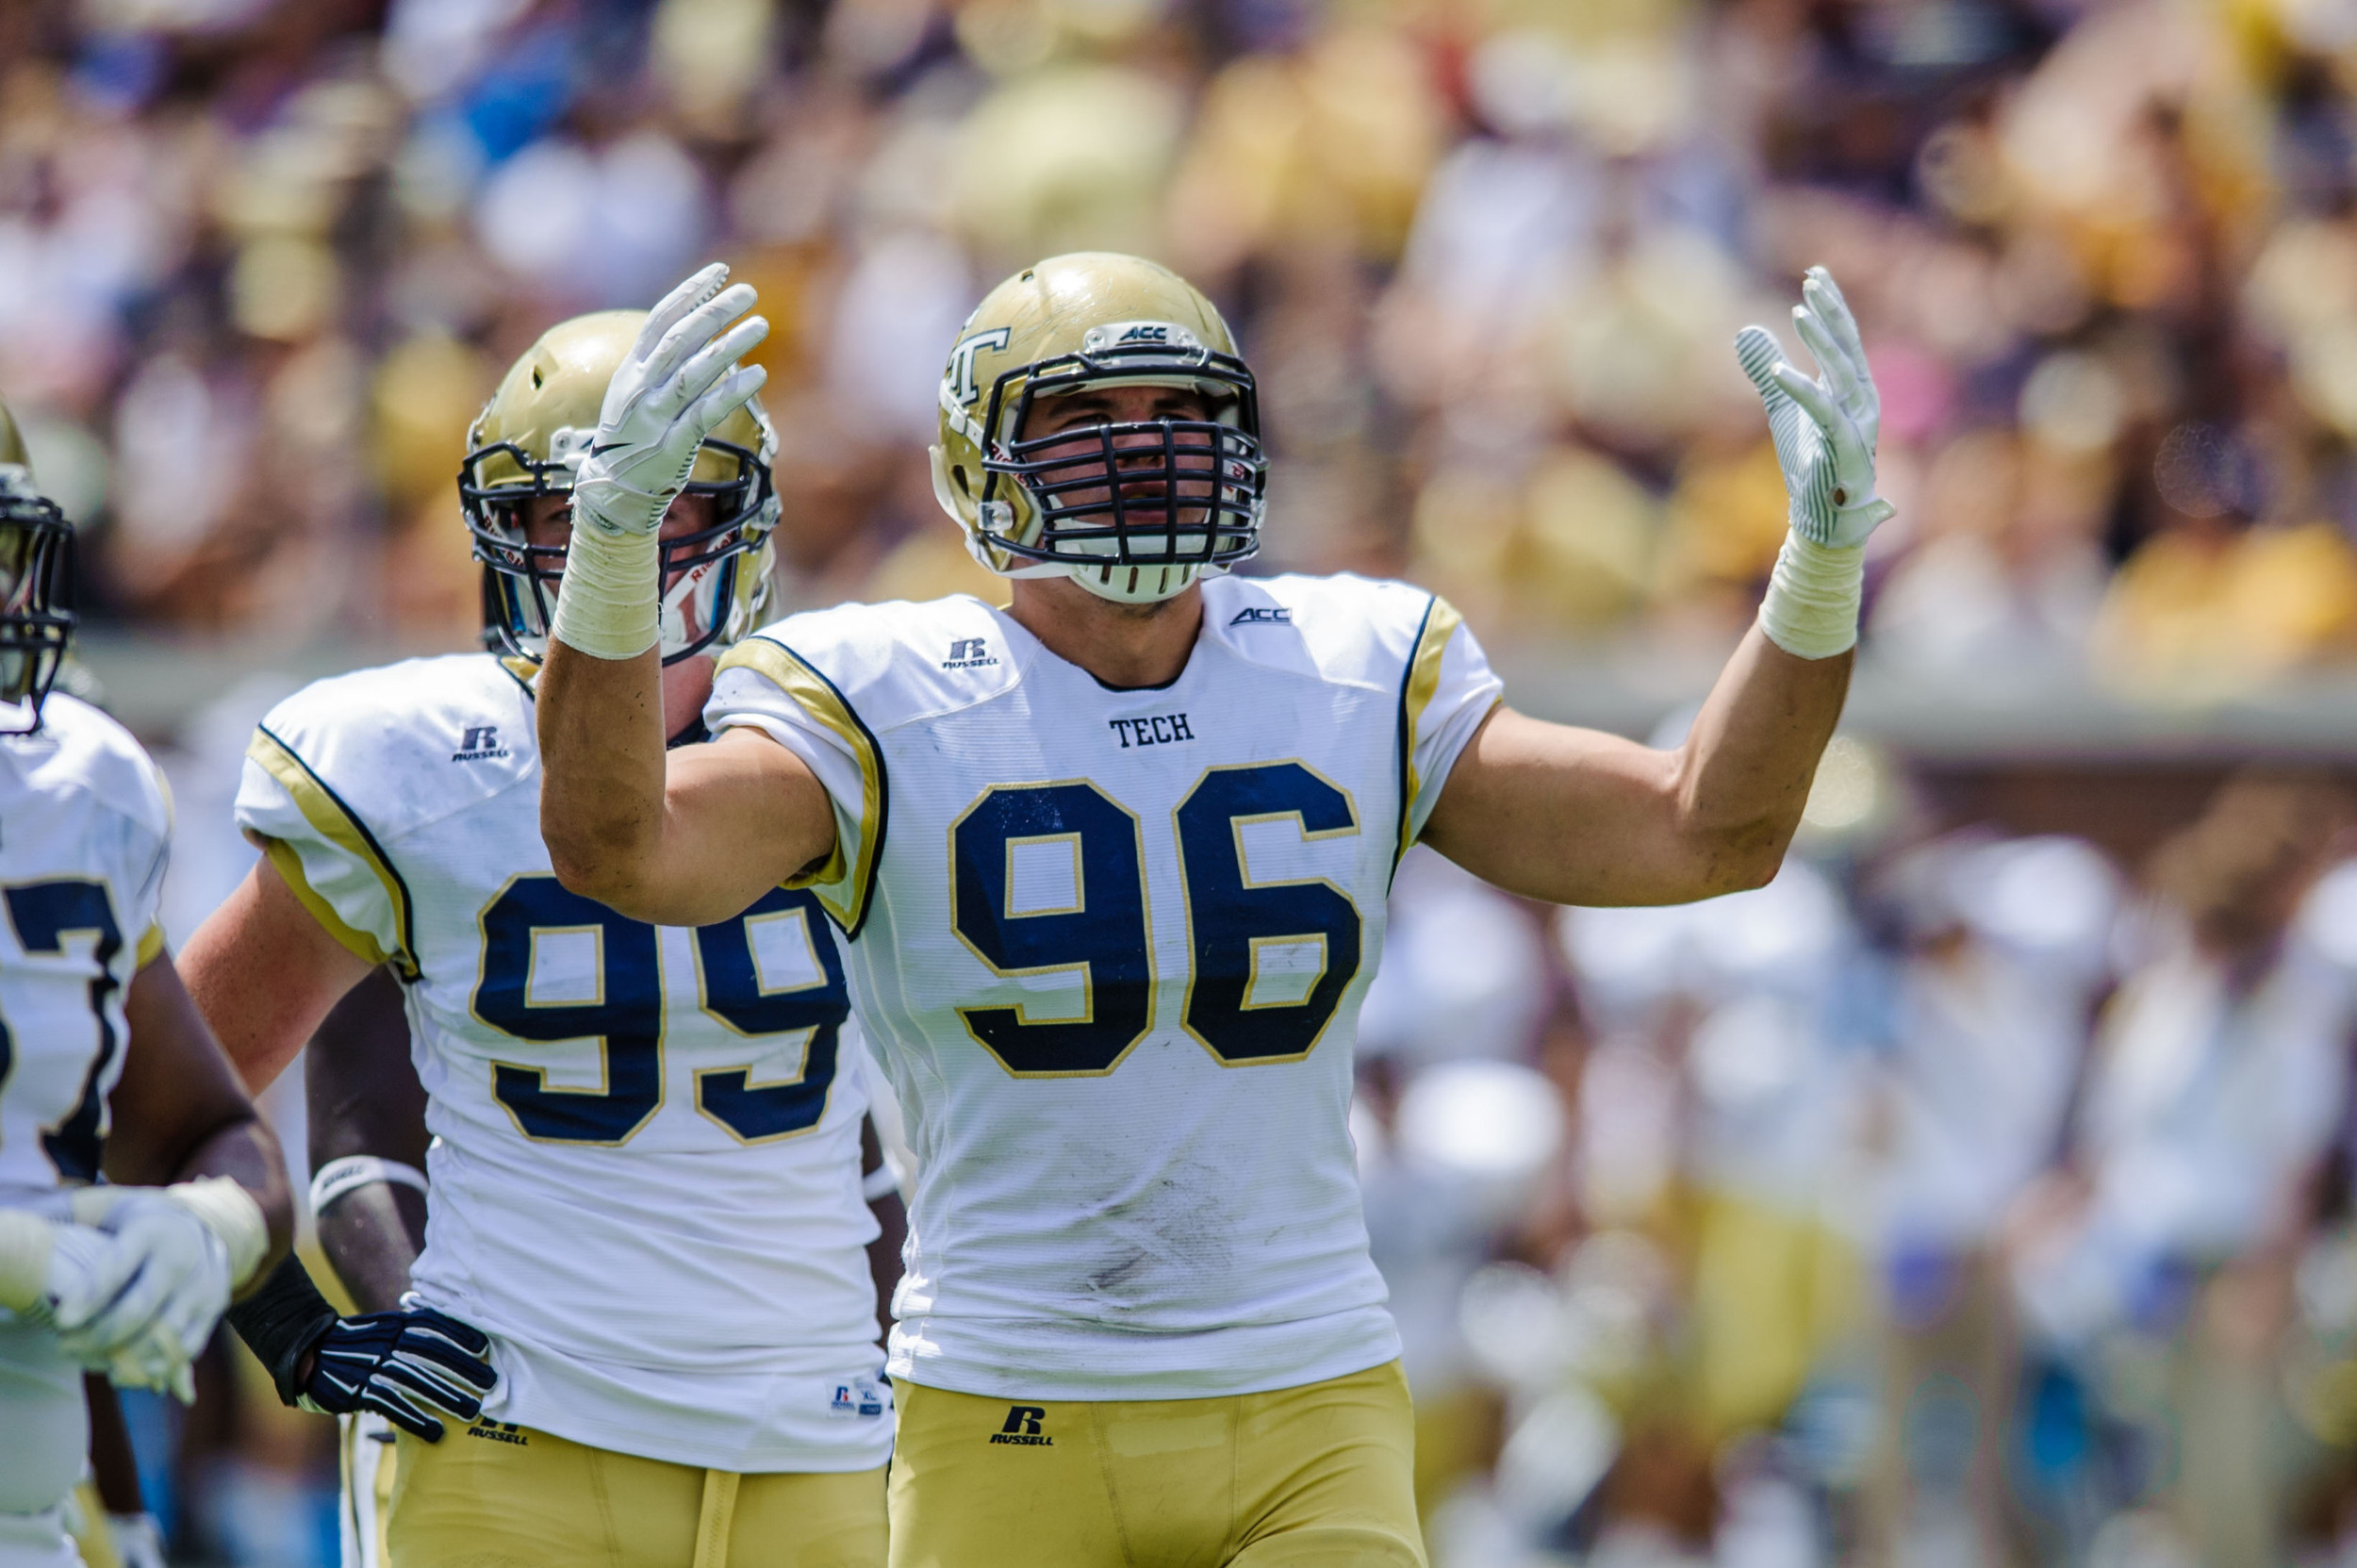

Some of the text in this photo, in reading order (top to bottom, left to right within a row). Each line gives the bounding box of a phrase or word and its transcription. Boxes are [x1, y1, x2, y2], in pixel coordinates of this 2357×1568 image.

[1118, 326, 1167, 340] ACC
[1228, 608, 1290, 626] ACC
[950, 637, 985, 659] R
[942, 658, 999, 668] RUSSELL
[462, 726, 497, 750] R
[1109, 713, 1195, 749] TECH
[452, 750, 508, 762] RUSSELL
[947, 757, 1363, 1080] 96
[470, 871, 851, 1147] 99
[1001, 1406, 1046, 1435] R
[468, 1427, 528, 1445] RUSSELL
[989, 1434, 1054, 1446] RUSSELL
